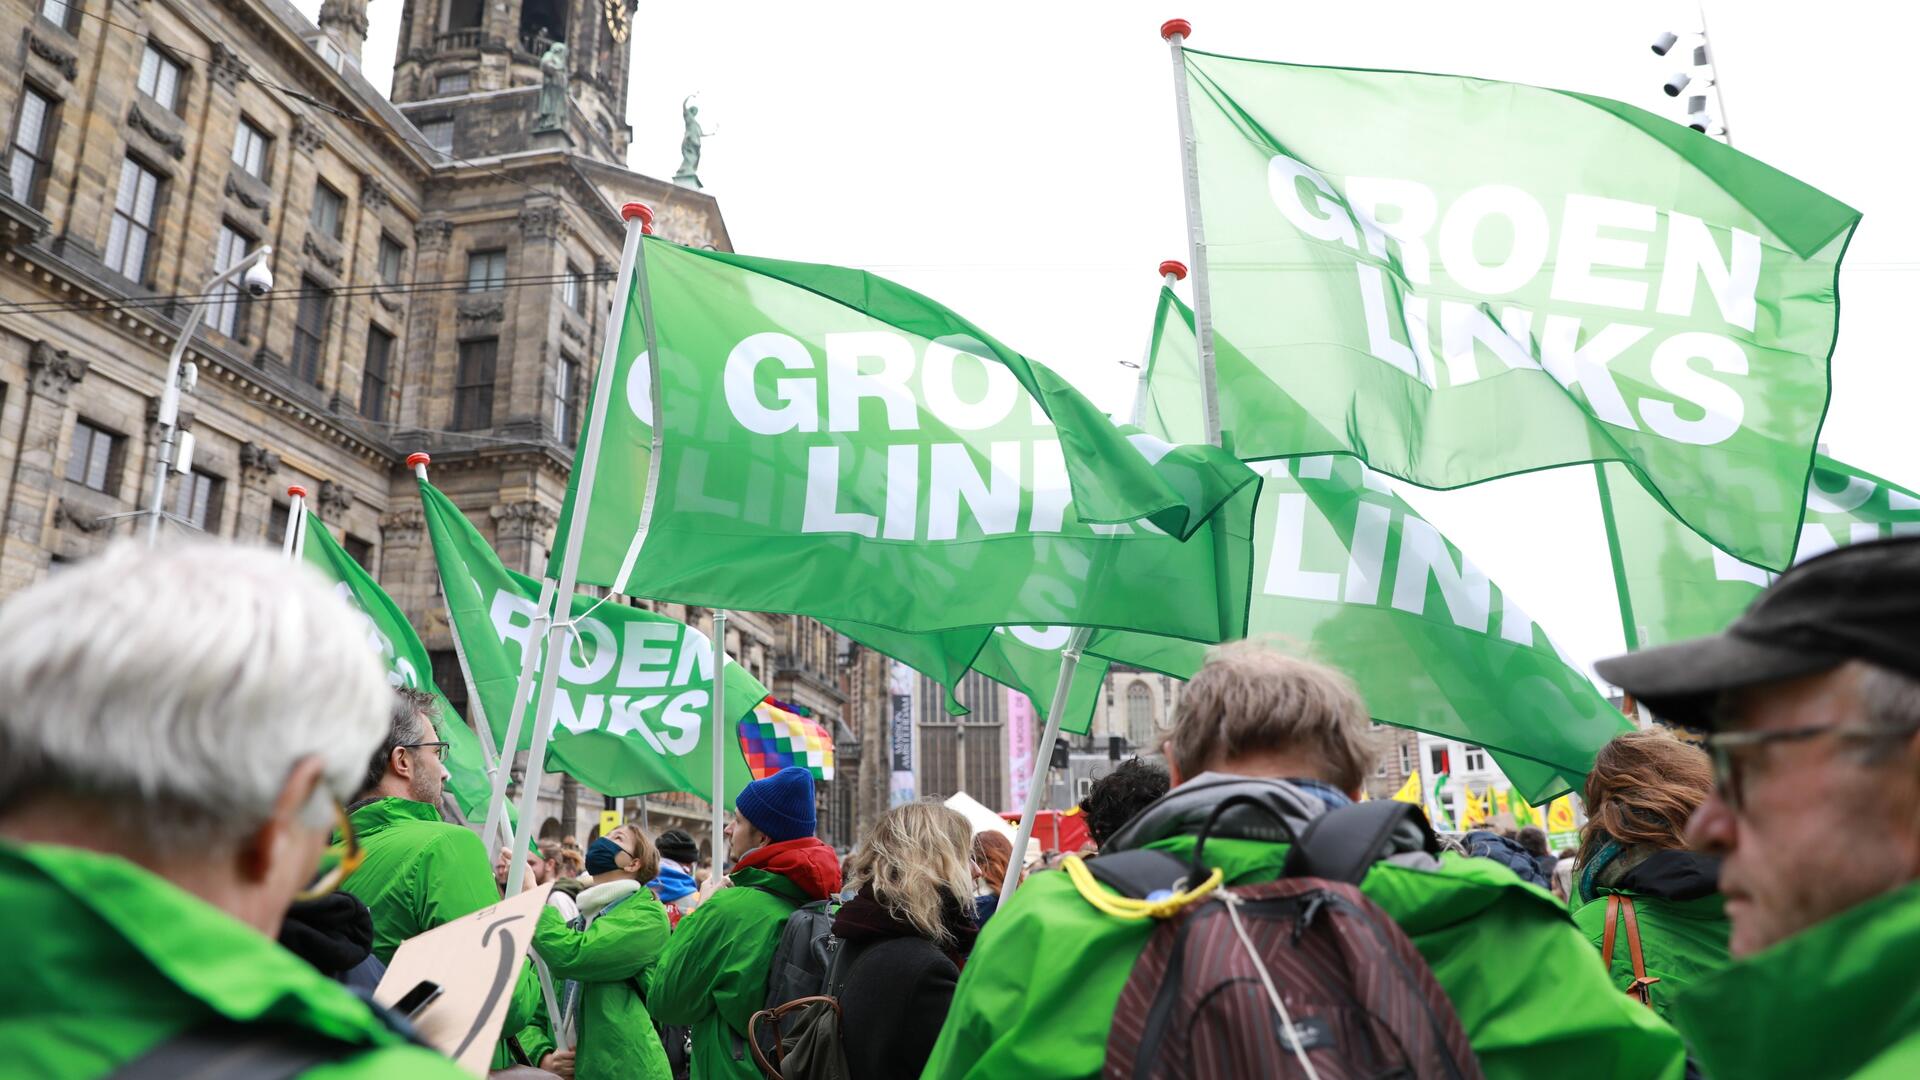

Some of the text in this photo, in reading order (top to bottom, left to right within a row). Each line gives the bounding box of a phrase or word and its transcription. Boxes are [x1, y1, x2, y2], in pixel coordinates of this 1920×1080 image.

[1267, 154, 1762, 332] GROEN
[724, 330, 1056, 435] GRO
[1356, 260, 1749, 446] LINKS
[489, 588, 734, 688] ROEN
[1263, 493, 1550, 660] LIN
[516, 675, 709, 756] NKS
